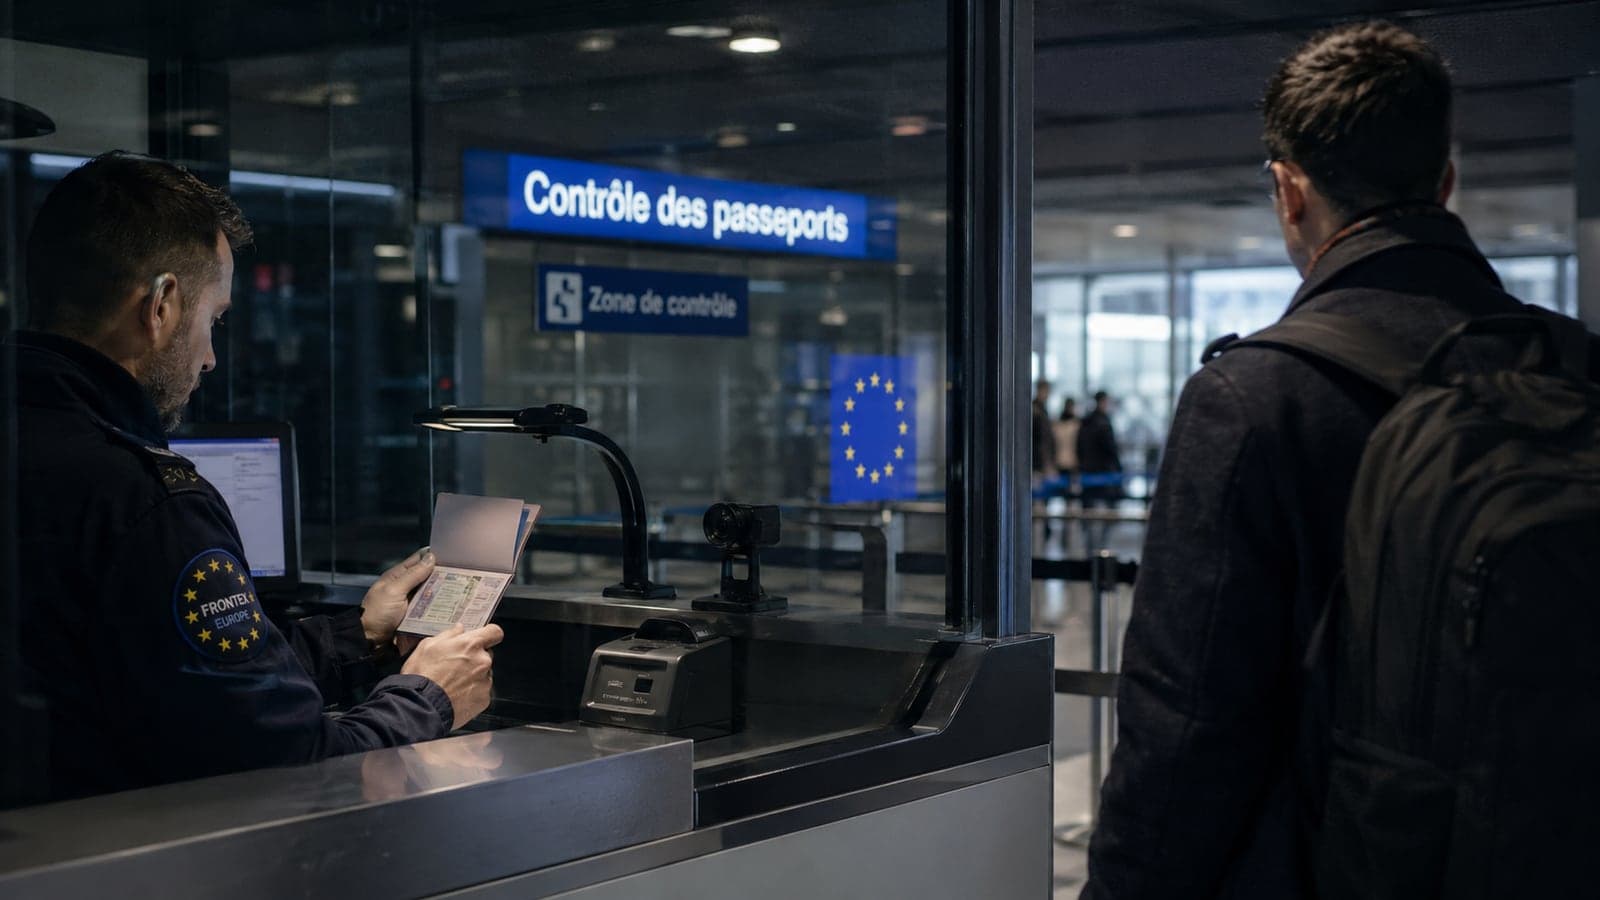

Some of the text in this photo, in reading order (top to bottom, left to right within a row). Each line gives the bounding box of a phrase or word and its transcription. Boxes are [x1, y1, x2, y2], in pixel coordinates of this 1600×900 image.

[524, 169, 849, 246] Contrôle des passeports
[588, 285, 738, 319] Zone de contrôle
[200, 592, 250, 617] FRONTEX
[214, 609, 251, 629] EUROPE
